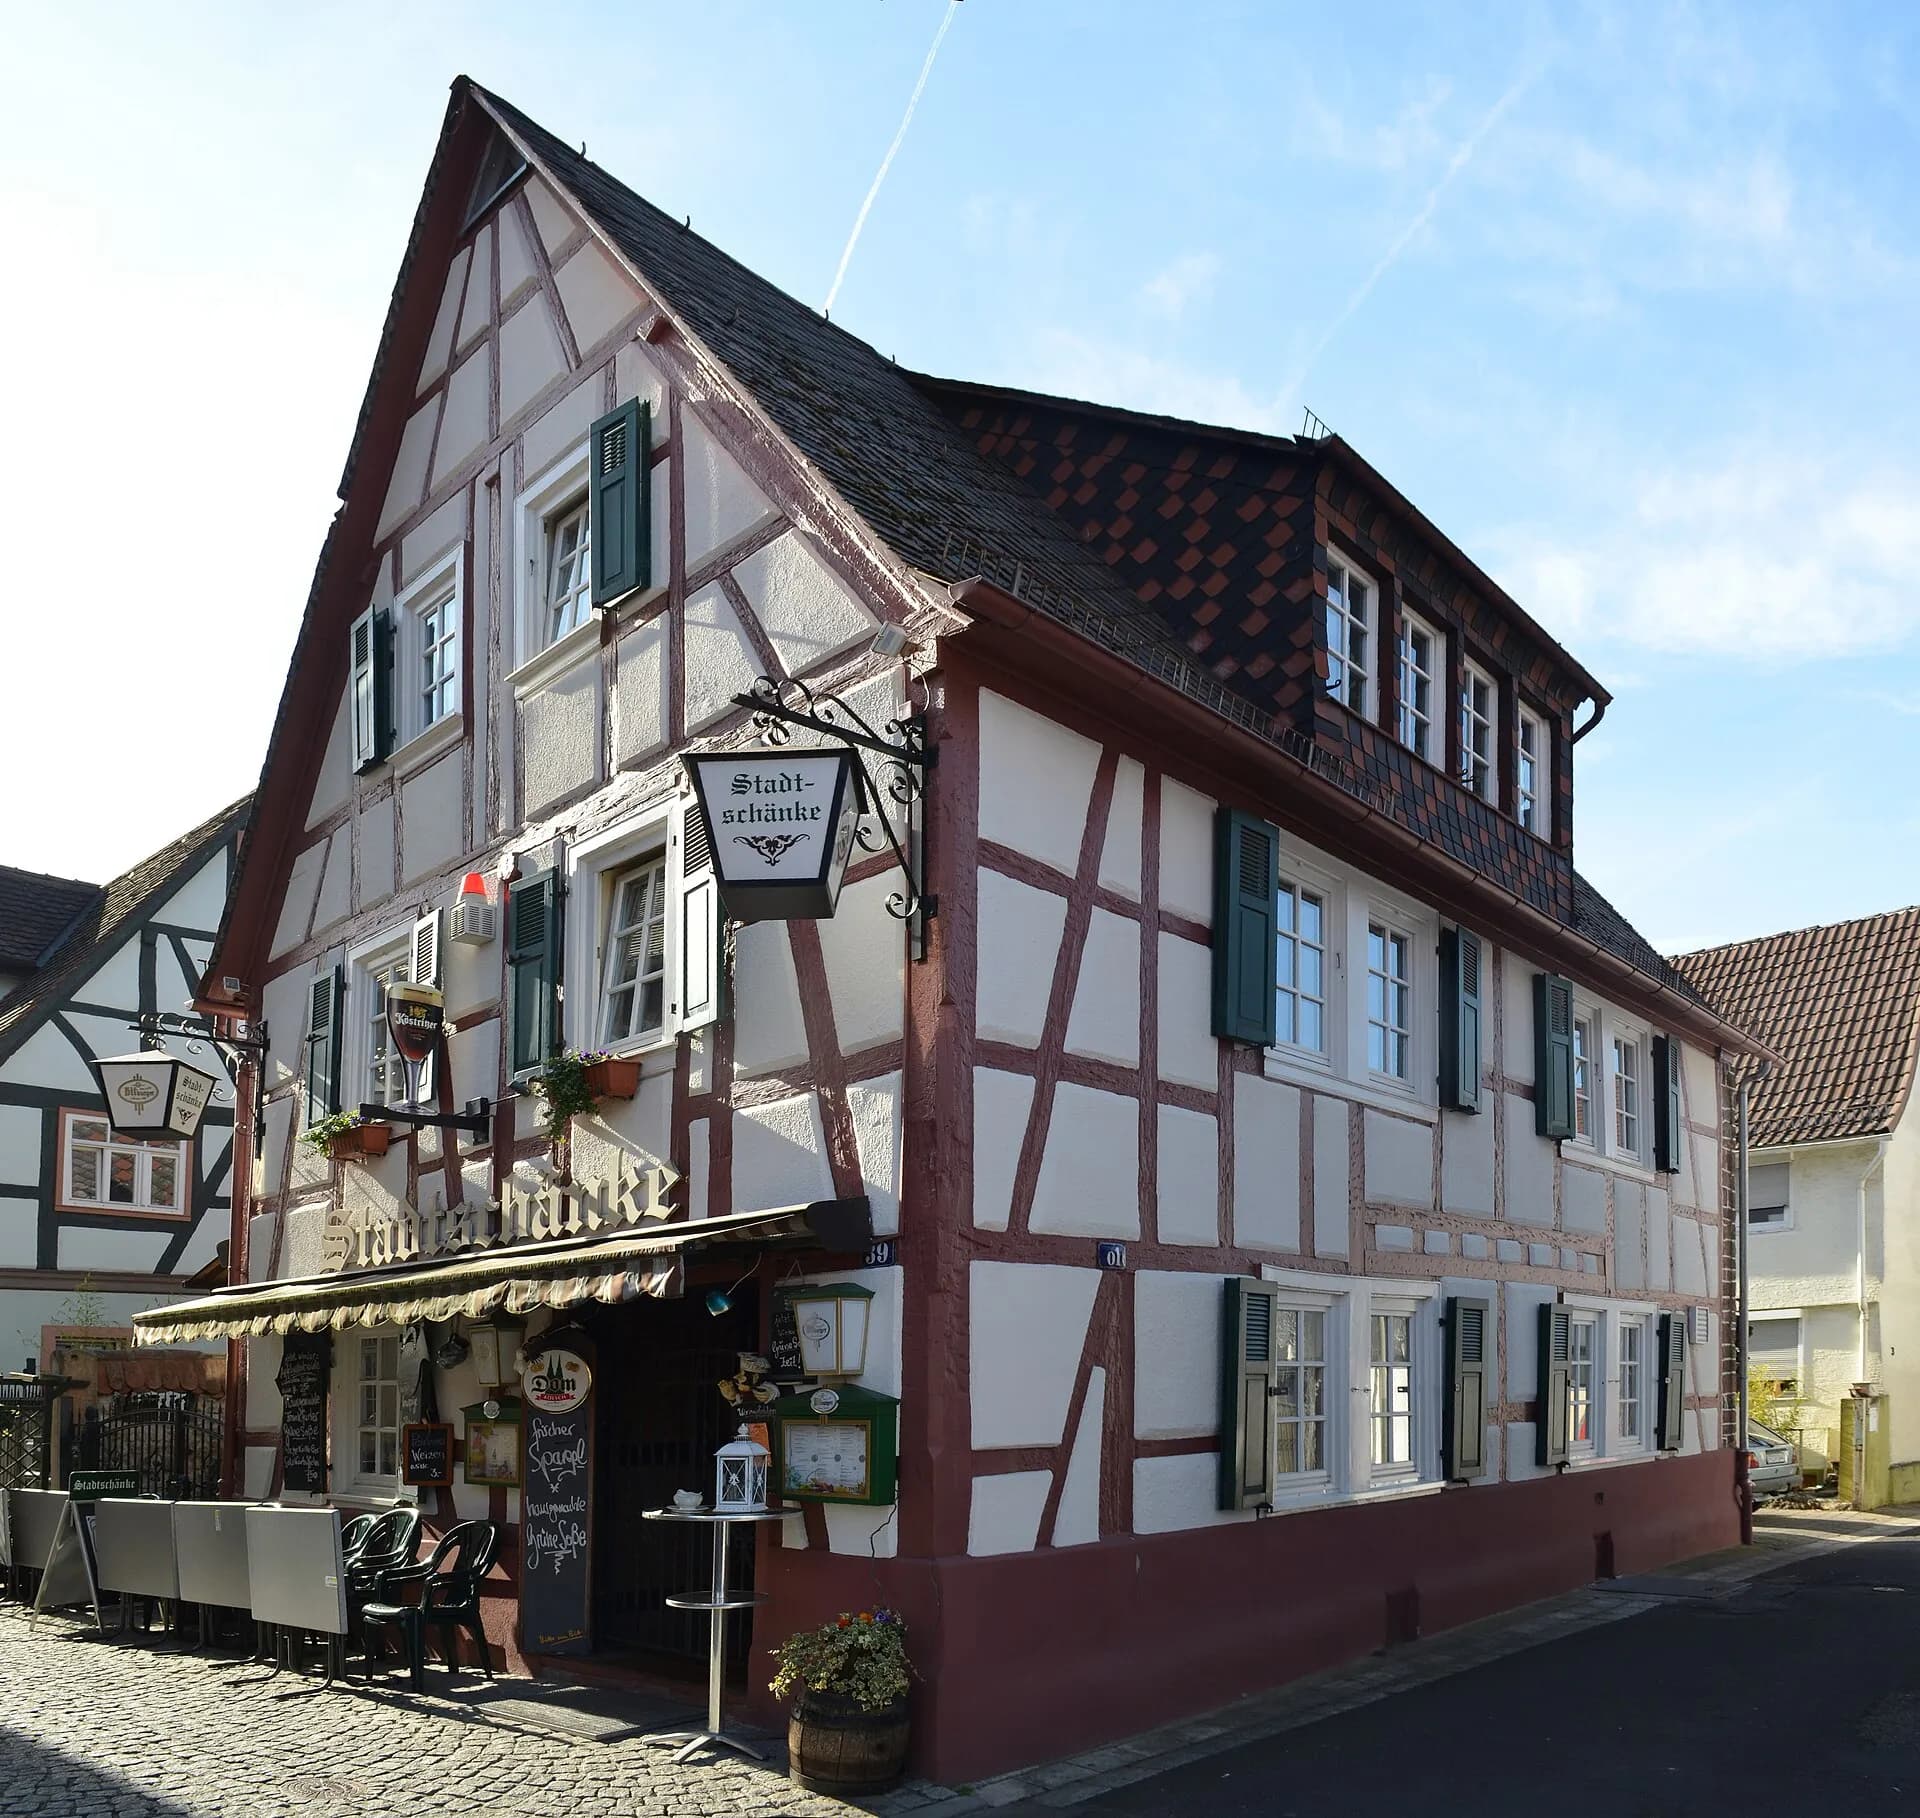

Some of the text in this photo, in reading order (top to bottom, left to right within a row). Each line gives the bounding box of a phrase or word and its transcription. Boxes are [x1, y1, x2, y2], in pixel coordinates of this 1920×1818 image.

[731, 773, 815, 796] Stadt-
[722, 801, 822, 825] schänke
[182, 1075, 205, 1093] Stadt-
[175, 1092, 203, 1109] schänke
[320, 1148, 682, 1274] Stadtschänke
[531, 1374, 576, 1393] Dom
[532, 1418, 575, 1451] frischer
[529, 1438, 588, 1482] Spargel
[73, 1479, 136, 1491] Stadtschänke
